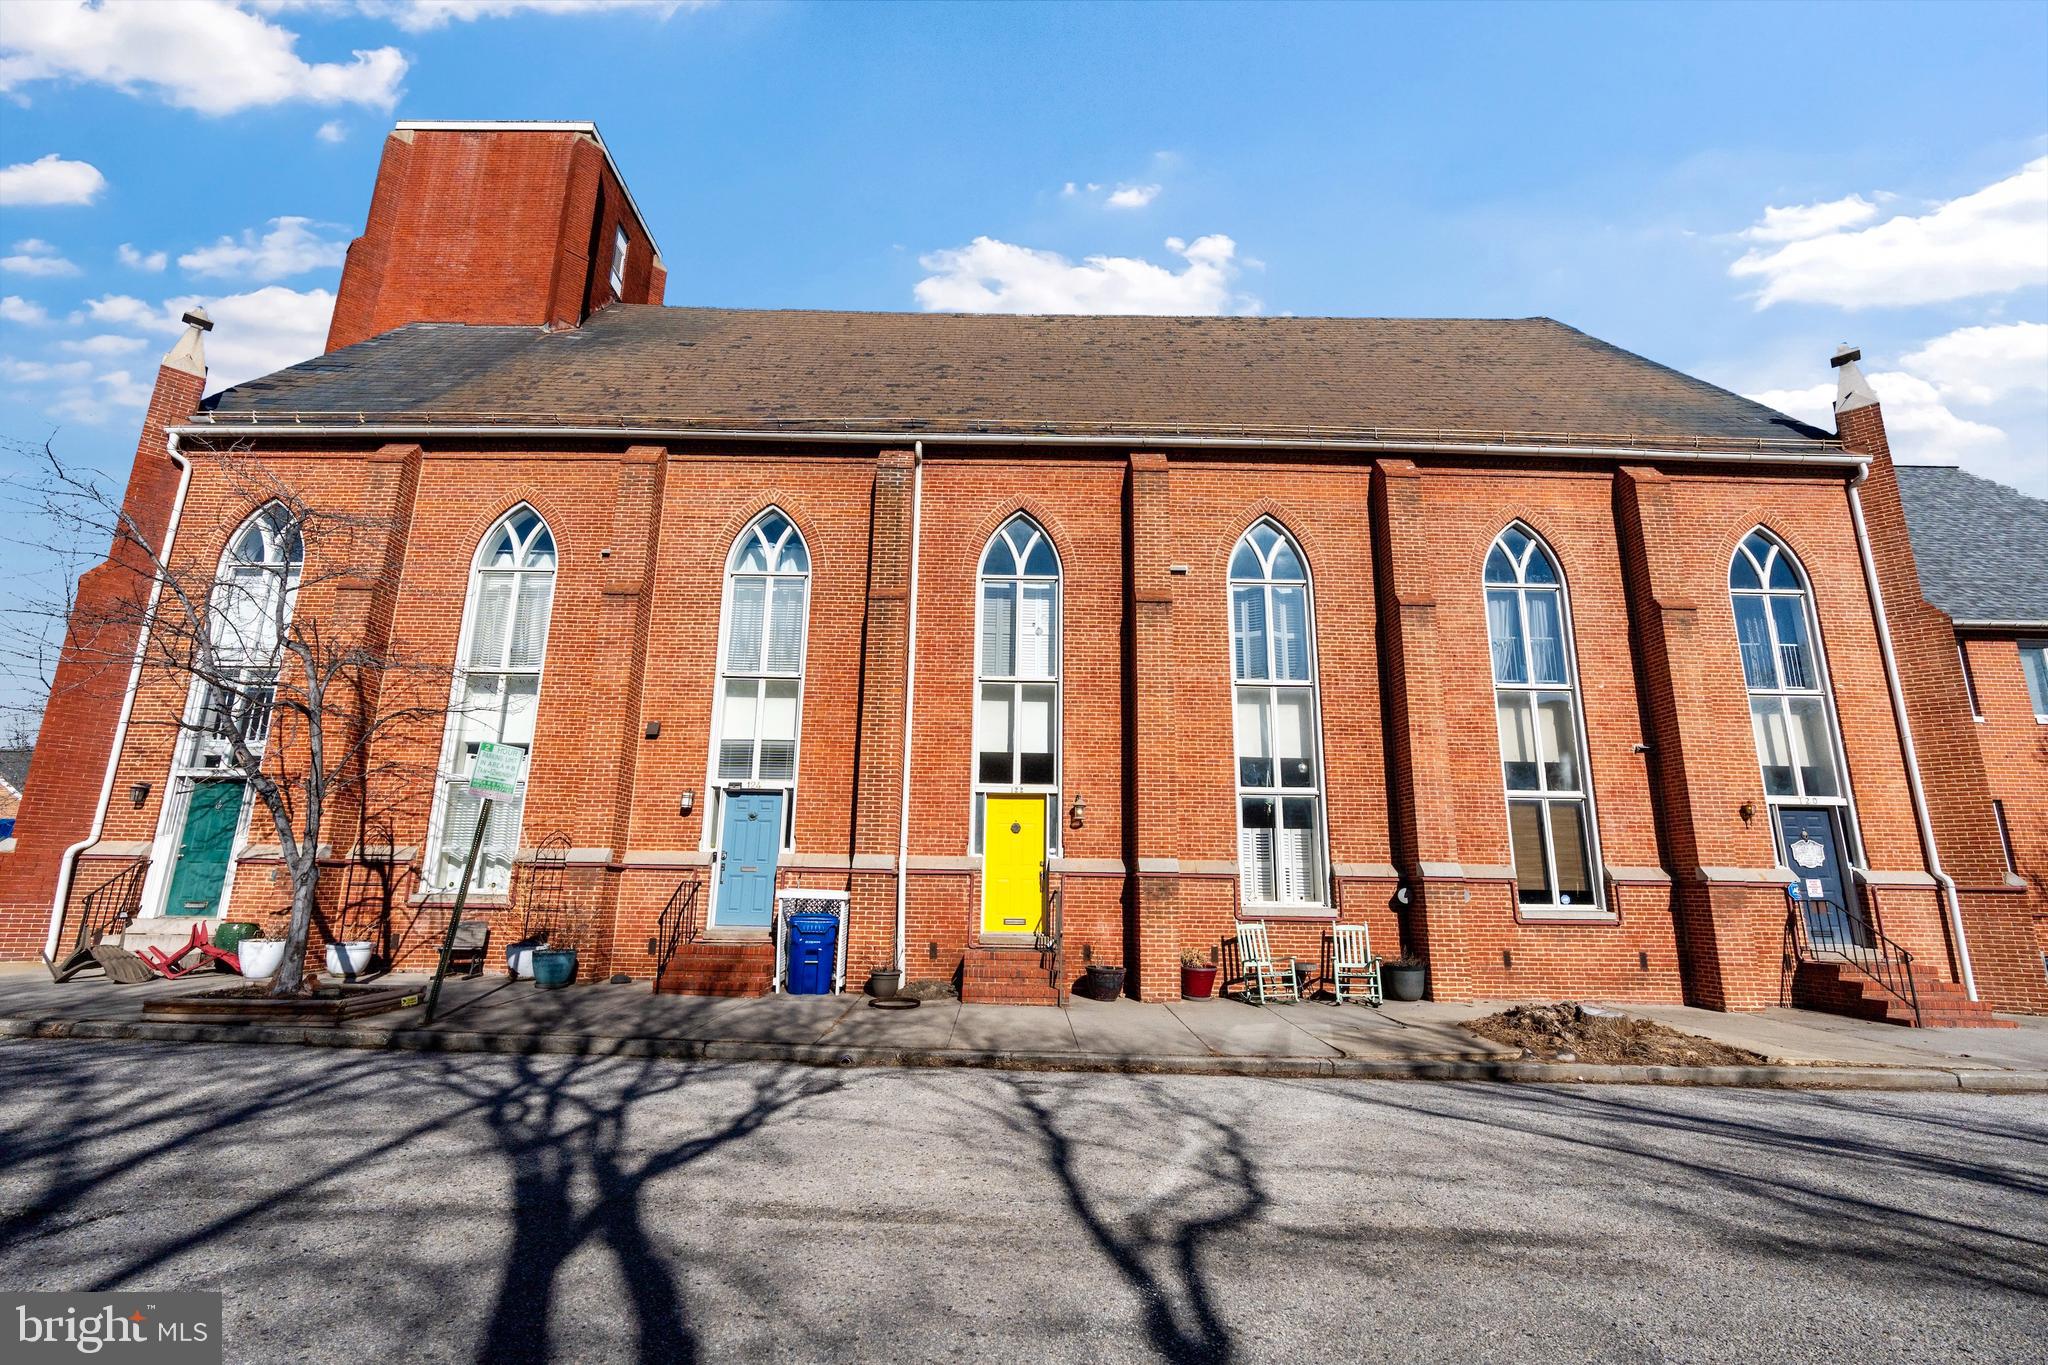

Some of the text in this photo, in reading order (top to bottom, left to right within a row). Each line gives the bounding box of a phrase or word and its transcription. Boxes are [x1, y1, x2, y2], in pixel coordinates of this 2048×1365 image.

[485, 744, 519, 757] 2 HOUR
[487, 761, 505, 769] AREA
[1799, 796, 1818, 805] 120
